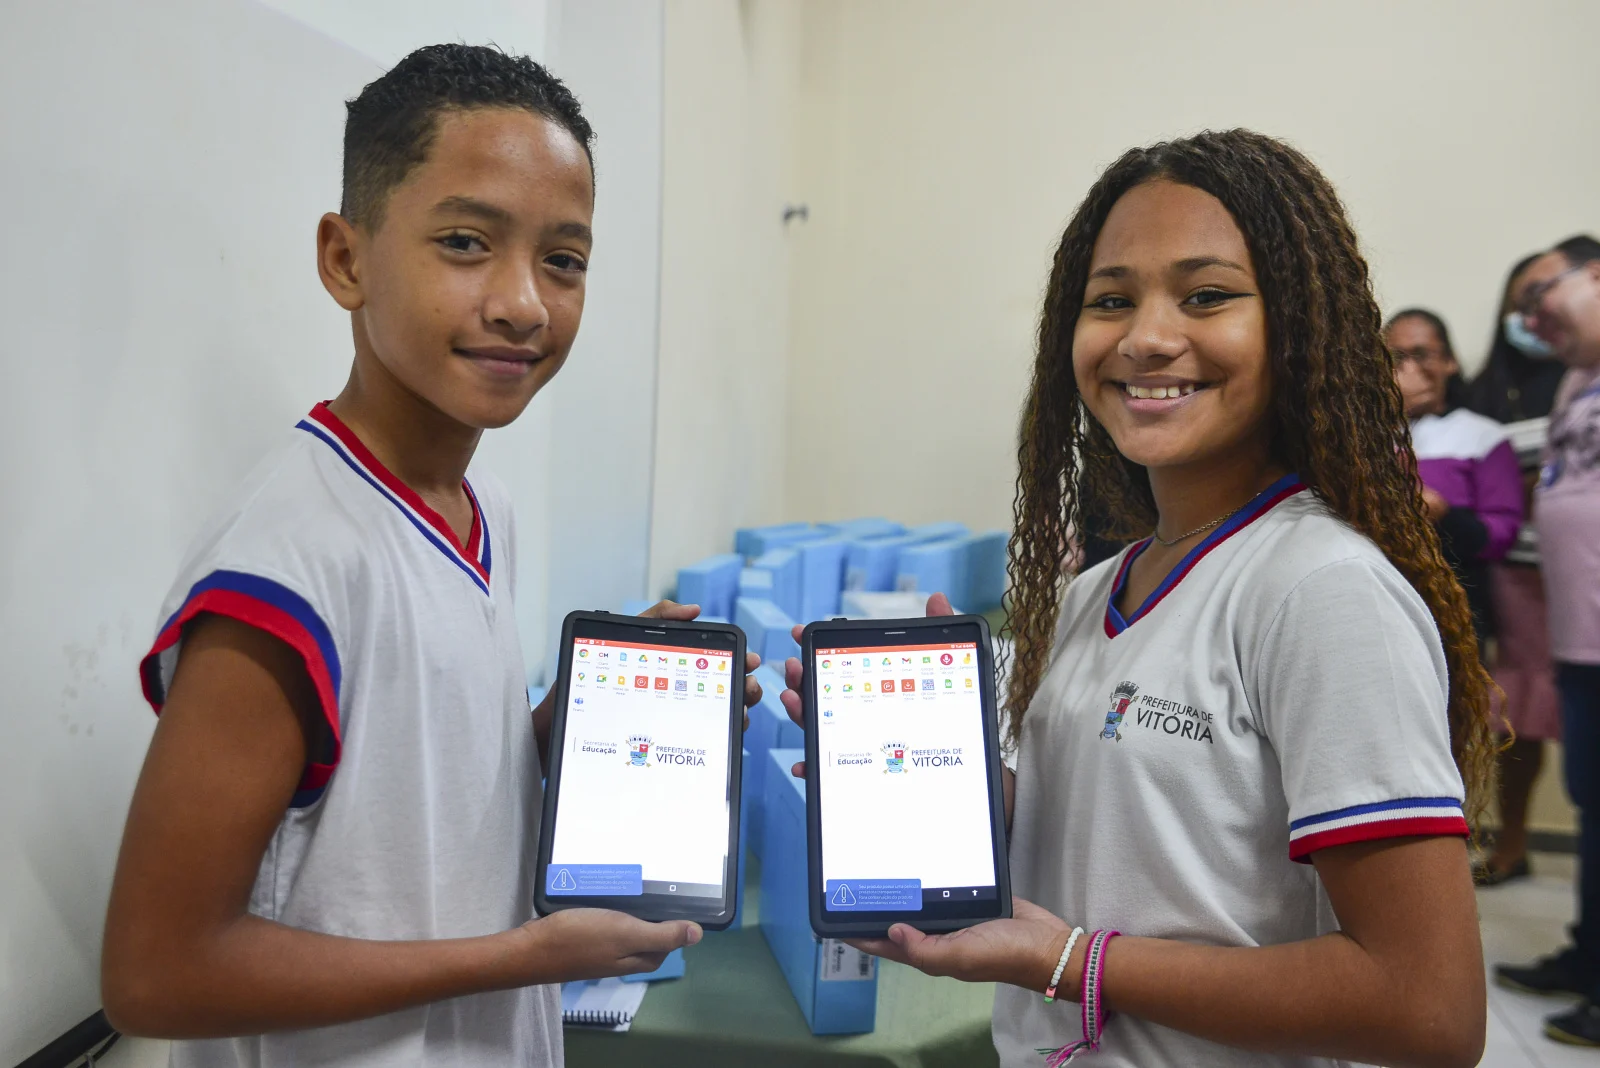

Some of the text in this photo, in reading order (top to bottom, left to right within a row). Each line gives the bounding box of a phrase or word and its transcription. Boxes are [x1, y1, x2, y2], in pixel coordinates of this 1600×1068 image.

[1141, 695, 1214, 724] PREFEITURA DE
[1137, 708, 1214, 744] VITÓRIA
[582, 745, 617, 754] Educação
[656, 746, 706, 756] PREFEITURA DE
[911, 748, 951, 756] PREFEITURA
[656, 752, 706, 767] VITÓRIA
[837, 758, 873, 766] Educação
[912, 754, 963, 767] VITÓRIA
